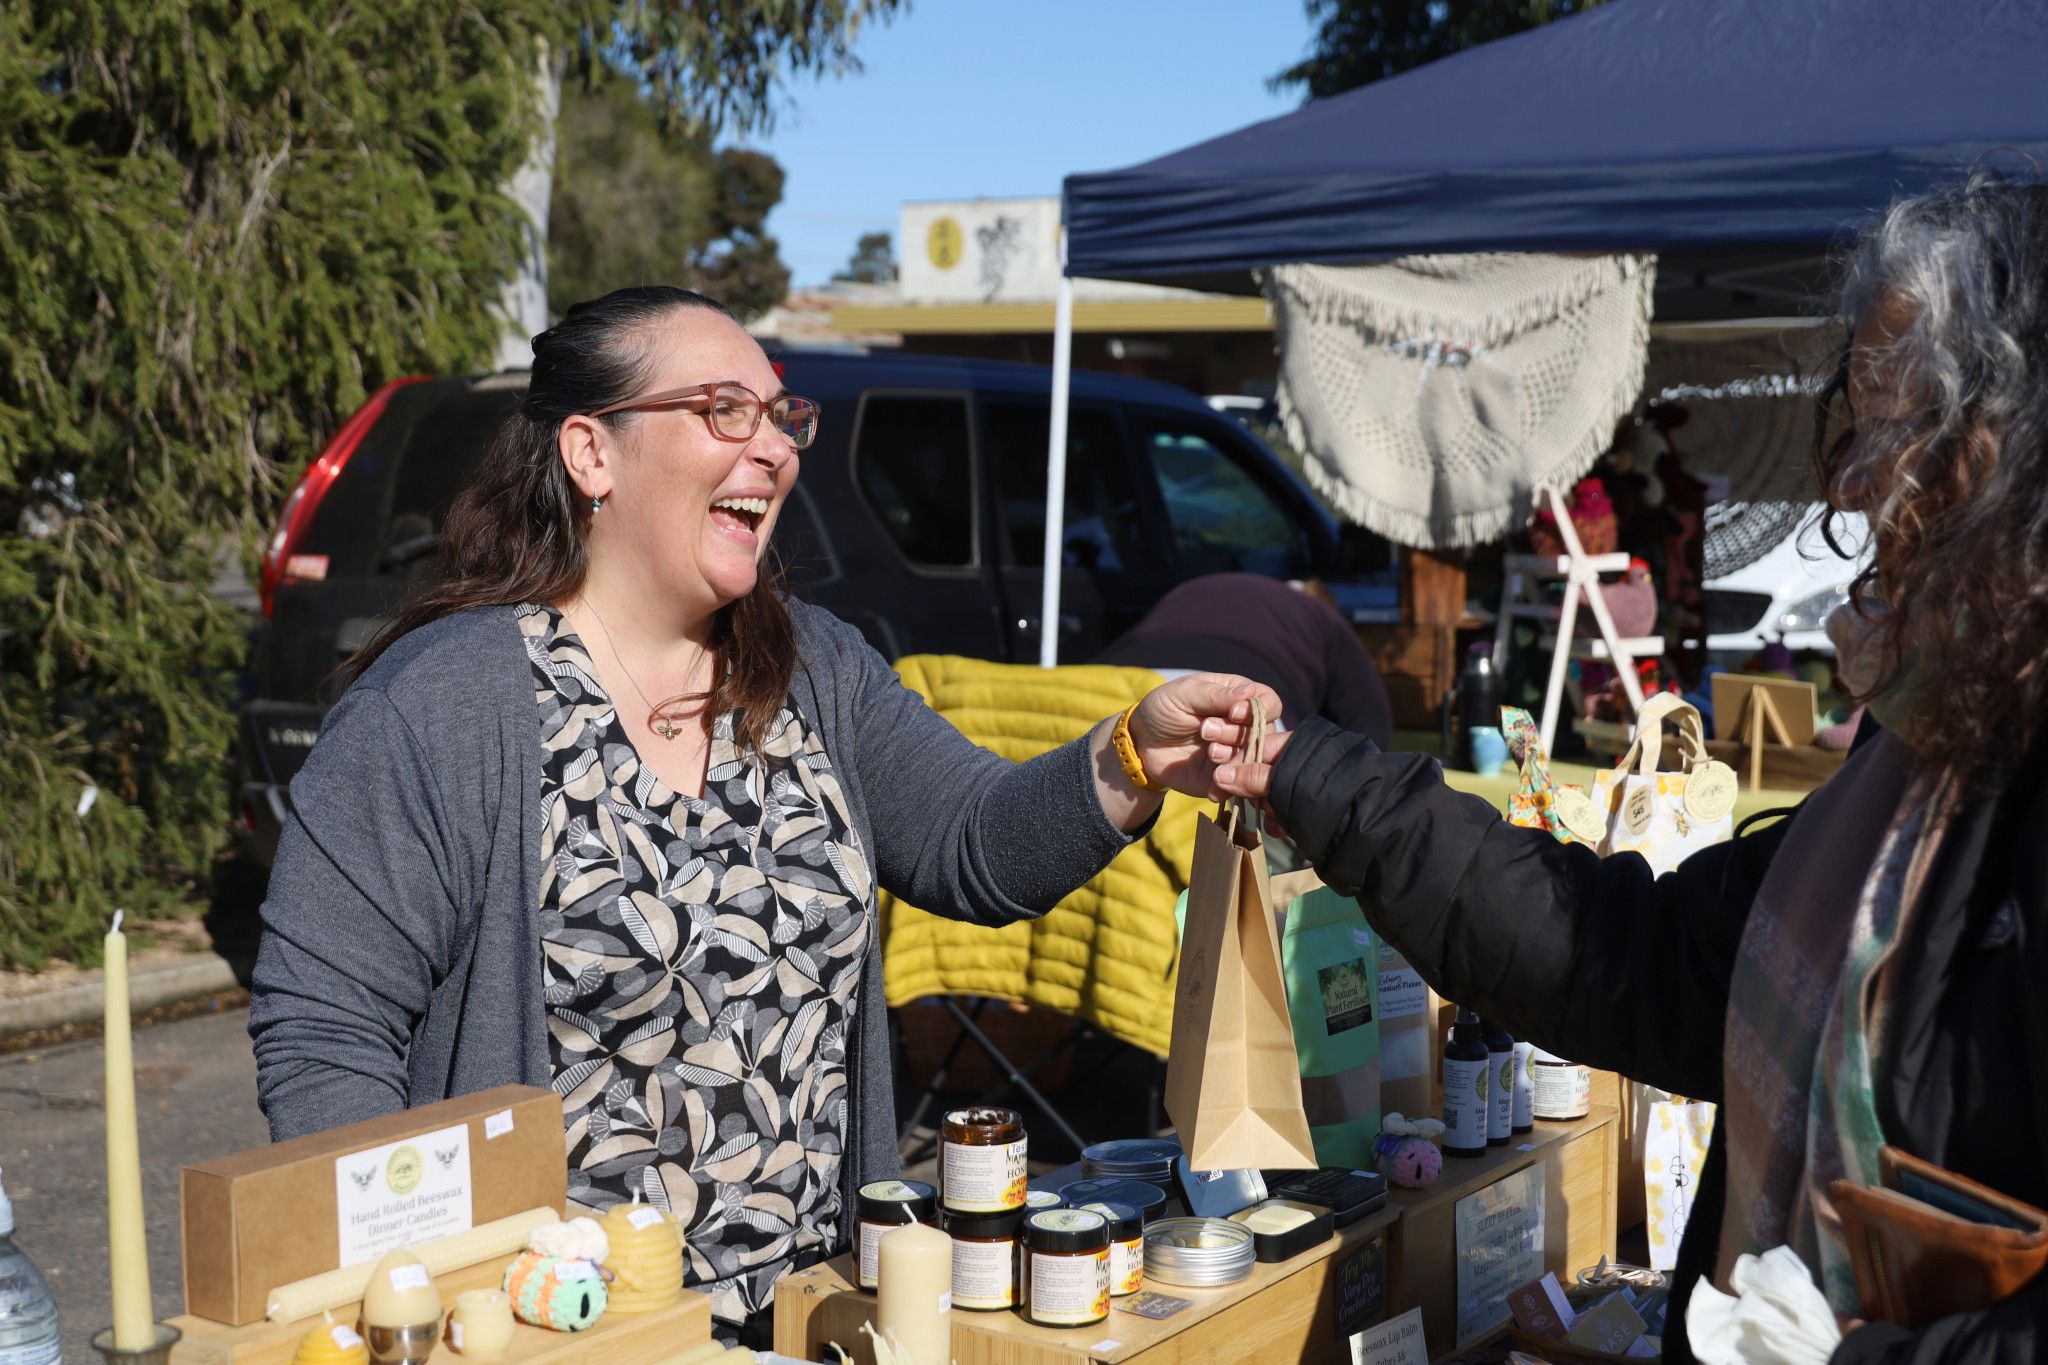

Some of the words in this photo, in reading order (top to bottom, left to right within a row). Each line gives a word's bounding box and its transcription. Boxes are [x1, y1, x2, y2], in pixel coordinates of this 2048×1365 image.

[1334, 986, 1358, 1000] Natural
[1403, 980, 1422, 990] Flakes
[1326, 1003, 1342, 1015] Plant
[351, 1205, 379, 1226] Hand
[383, 1196, 416, 1215] Rolled
[418, 1186, 463, 1206] Beeswax
[368, 1218, 403, 1237] Dinner
[407, 1205, 448, 1226] Candles
[1388, 1331, 1401, 1345] Lip
[1401, 1322, 1418, 1338] Balm
